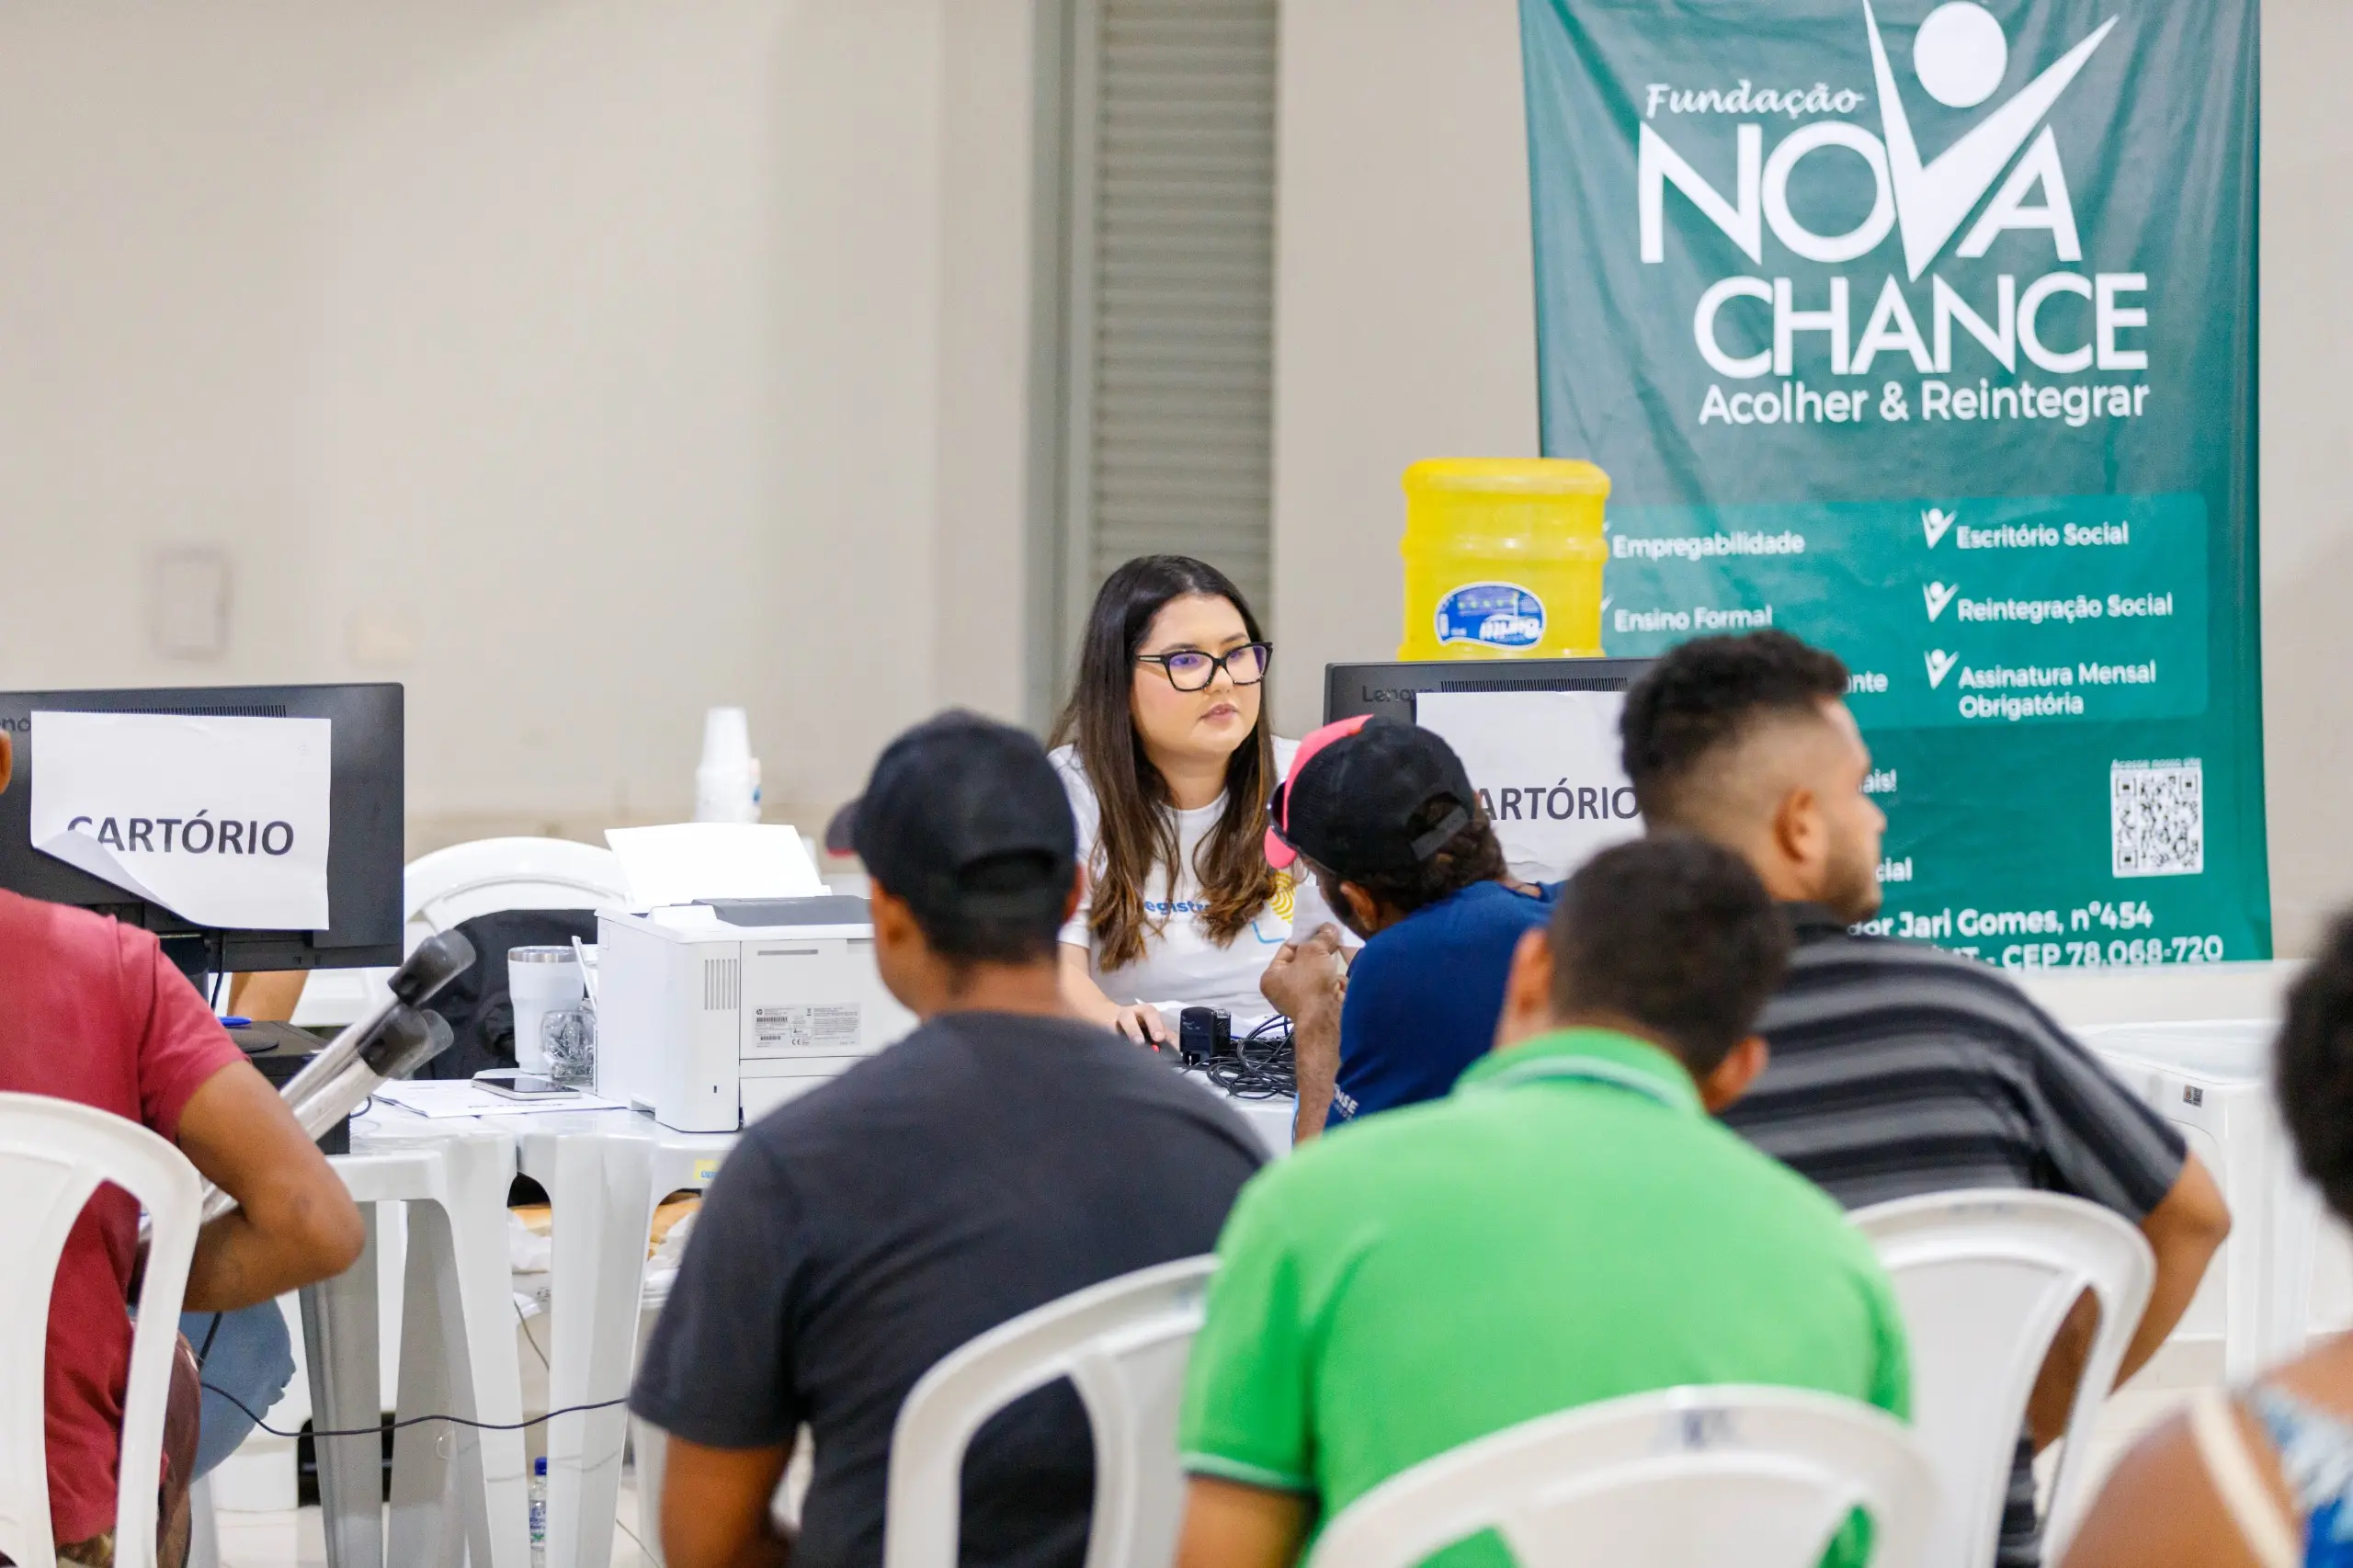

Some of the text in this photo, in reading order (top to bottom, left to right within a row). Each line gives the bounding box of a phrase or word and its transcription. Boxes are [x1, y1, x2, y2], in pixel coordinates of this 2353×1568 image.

[1645, 79, 1866, 119] Fundação
[1693, 272, 2148, 378] CHANCE
[1699, 378, 2150, 427] Acolher & Reintegrar
[1612, 530, 1805, 561] Empregabilidade
[1956, 520, 2129, 549] Escritório Social
[1614, 605, 1773, 632] Ensino Formal
[1958, 592, 2173, 624] Reintegração Social
[1958, 659, 2156, 689] Assinatura Mensal
[1959, 691, 2084, 722] Obrigatória
[1860, 768, 1897, 793] ais!
[1475, 778, 1642, 821] ARTÓRIO
[1875, 857, 1913, 882] cial
[1898, 907, 1951, 938] Jari
[1957, 907, 2064, 937] Gomes,
[2002, 943, 2062, 967] CEP
[2065, 935, 2224, 965] 78.068-720
